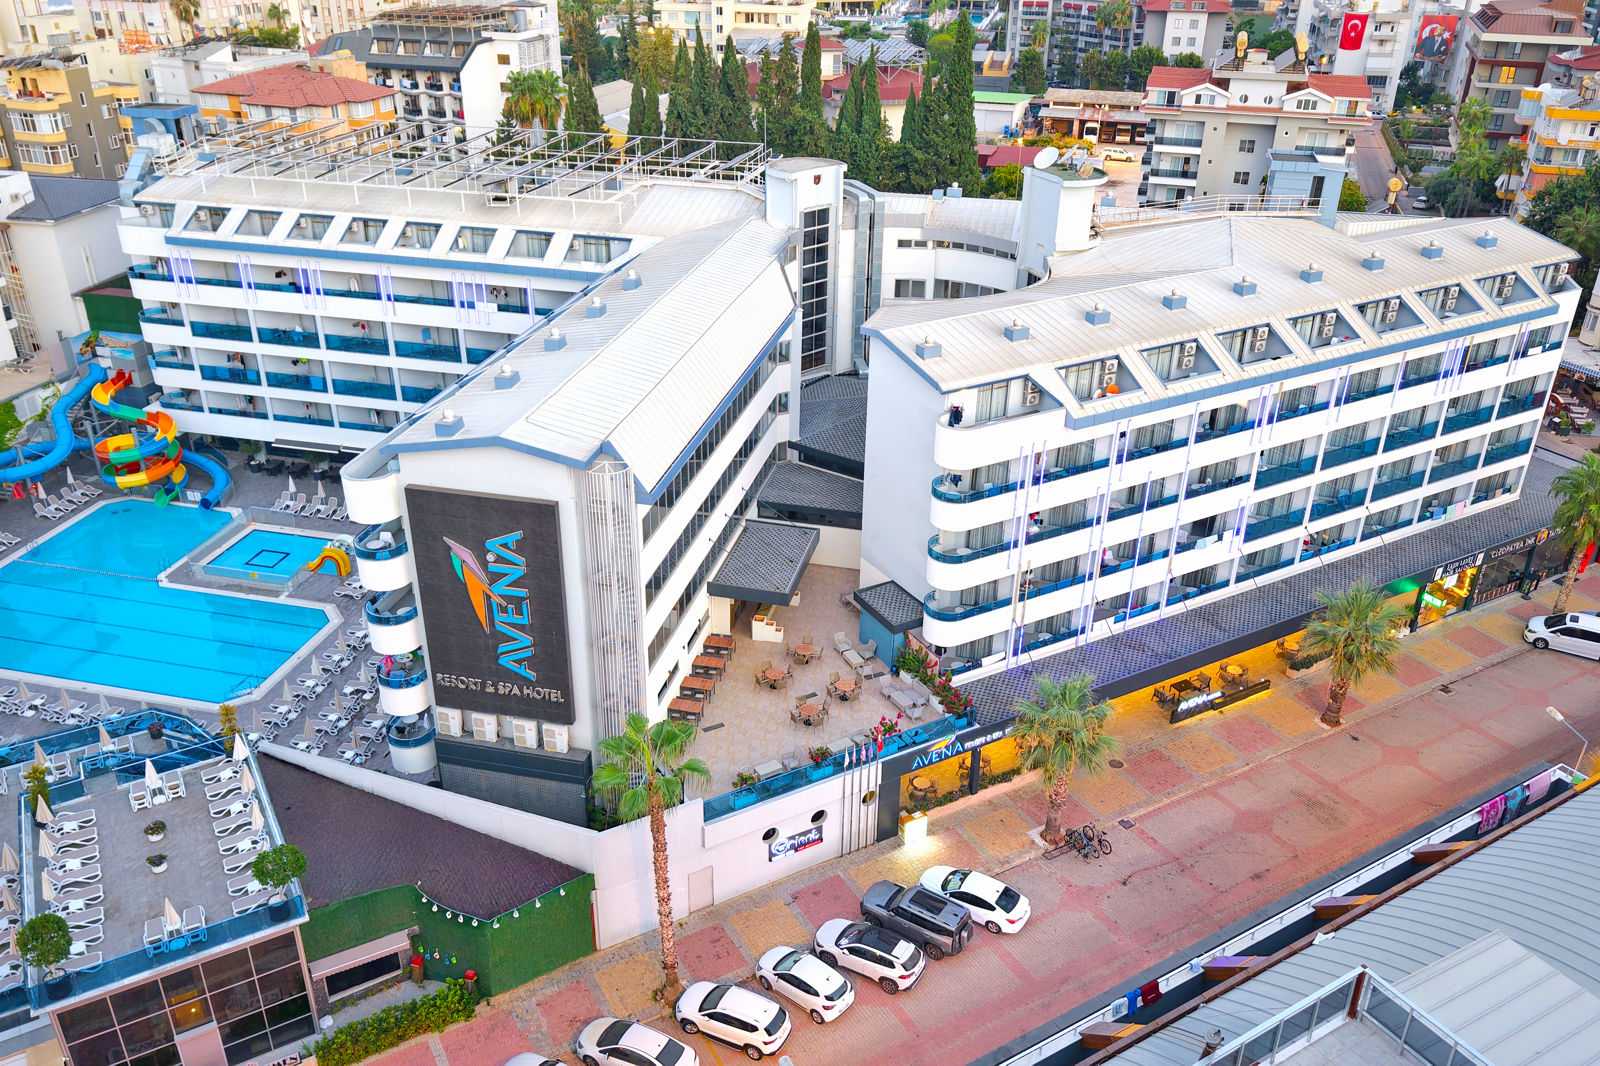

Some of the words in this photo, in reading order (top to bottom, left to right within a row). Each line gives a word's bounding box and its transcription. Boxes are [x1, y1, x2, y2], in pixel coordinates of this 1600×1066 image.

[1491, 541, 1524, 558] CLEOPATRA
[485, 530, 536, 681] AVENA
[435, 673, 482, 691] RESORT
[485, 681, 495, 693] &
[498, 682, 521, 697] SPA
[523, 686, 565, 703] HOTEL
[912, 741, 964, 770] AVENA
